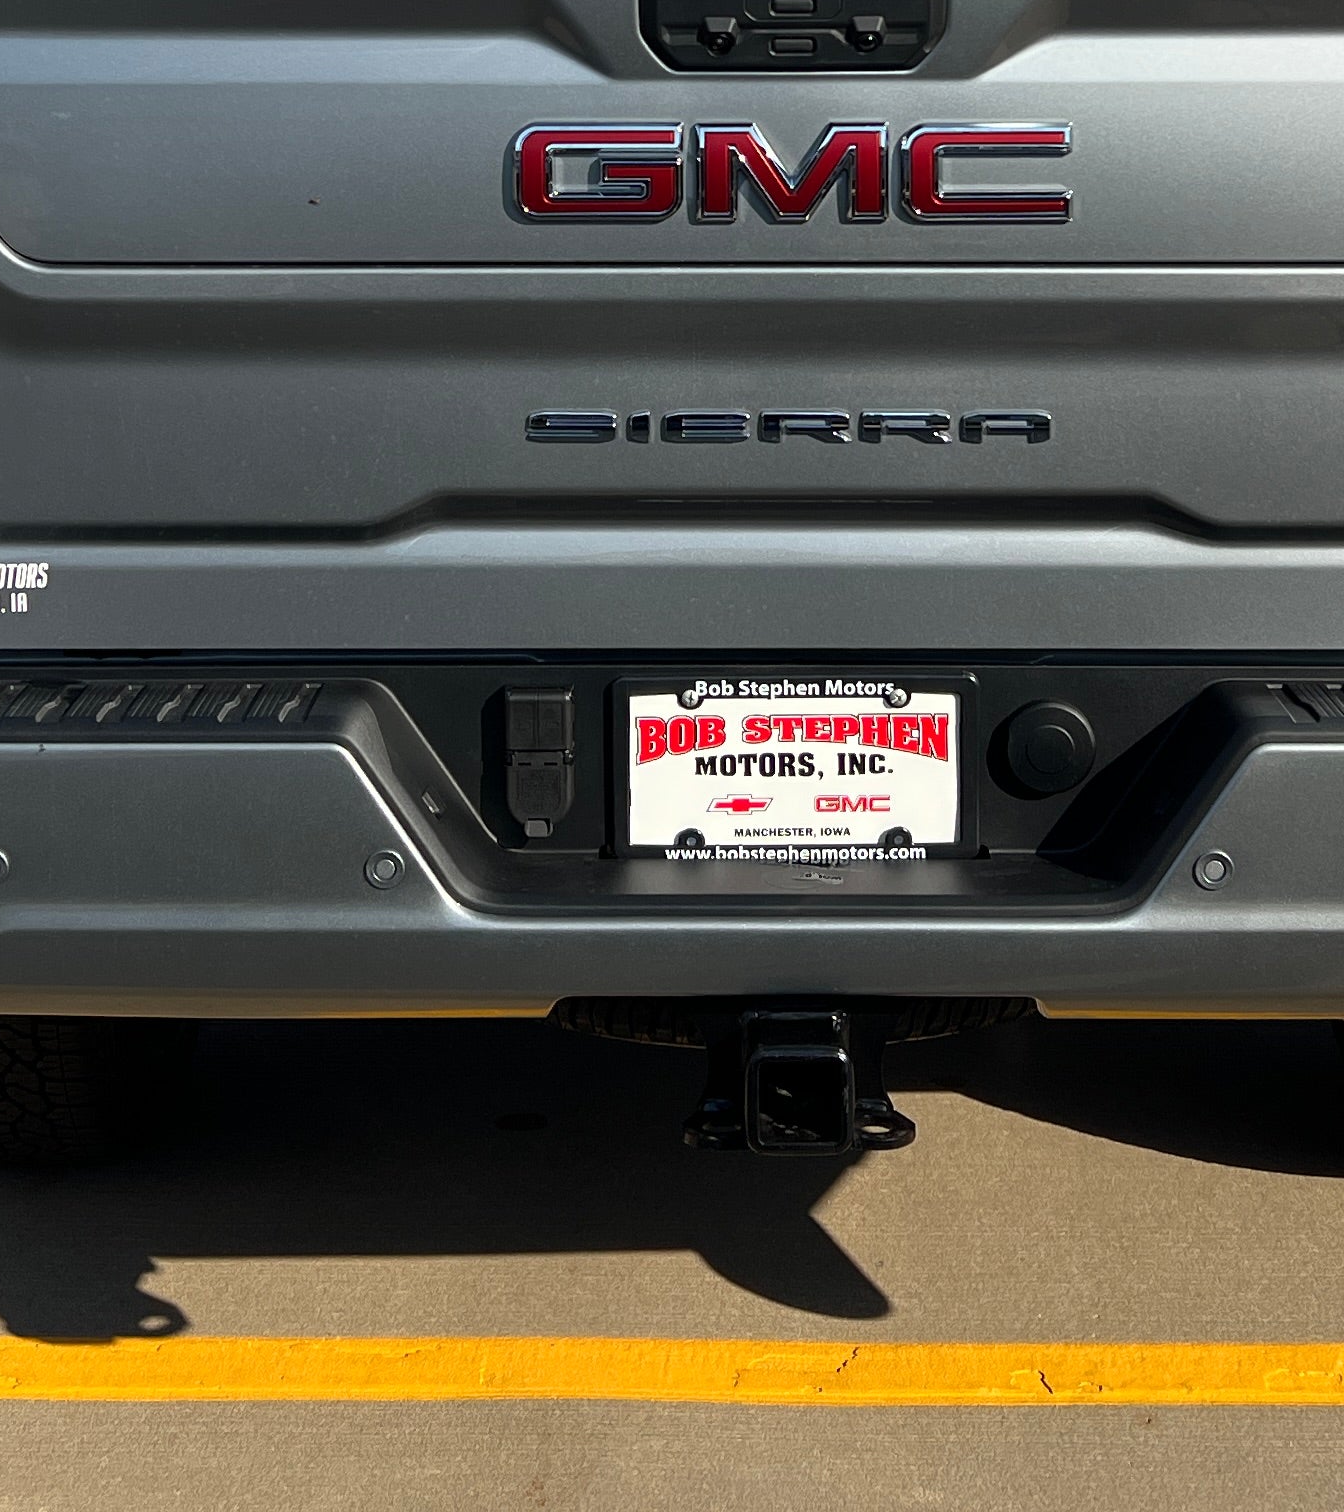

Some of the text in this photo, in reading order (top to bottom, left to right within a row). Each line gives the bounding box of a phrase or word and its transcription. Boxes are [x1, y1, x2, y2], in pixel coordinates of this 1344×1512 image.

[515, 122, 1073, 223] GMC
[525, 407, 1054, 445] SIERRA
[10, 592, 29, 613] IA
[694, 679, 895, 699] Bob Stephen Motors
[635, 713, 949, 766] BOB STEPHEN
[694, 752, 894, 780] MOTORS, INC.
[813, 794, 891, 813] GMC
[734, 827, 851, 839] MANCHESTER, IOWA
[665, 845, 927, 861] www.bobstephenmotors.com
